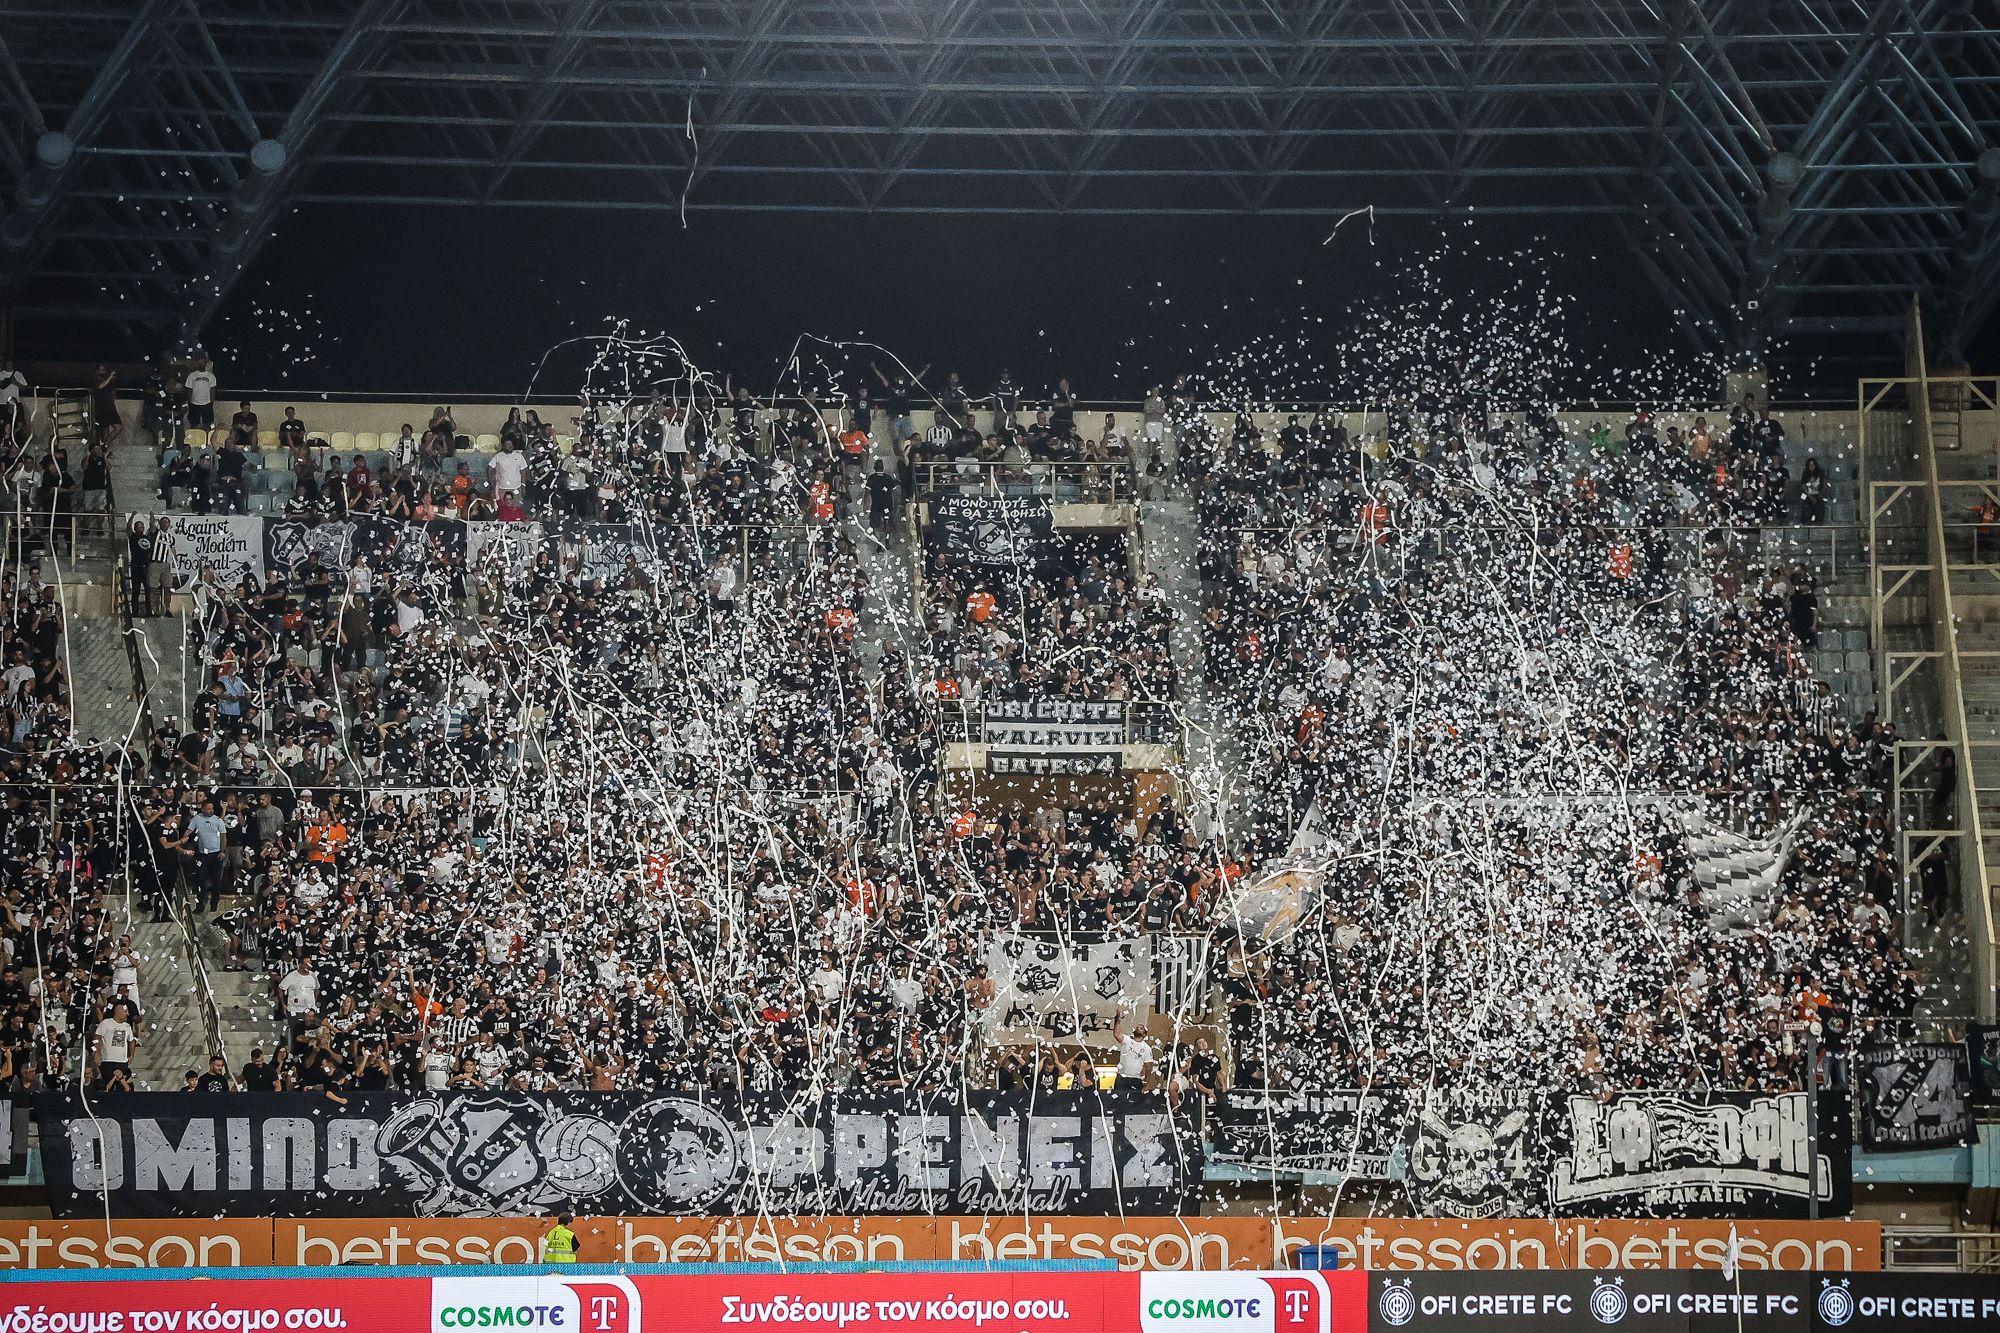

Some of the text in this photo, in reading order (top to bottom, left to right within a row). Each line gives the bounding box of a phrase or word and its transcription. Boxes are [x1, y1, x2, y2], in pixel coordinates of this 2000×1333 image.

[938, 506, 957, 516] ΔΕ
[962, 508, 981, 518] ΘΑ
[174, 517, 230, 541] Against
[195, 535, 248, 554] Modern
[176, 553, 230, 571] Fooall
[1036, 701, 1122, 720] CRETE
[986, 728, 1123, 746] MALEVIZI
[992, 756, 1066, 776] GATE
[1919, 1117, 1967, 1140] team
[1362, 1159, 1389, 1176] YOU
[843, 1174, 950, 1214] Modern
[957, 1175, 1069, 1214] Football
[1476, 1198, 1501, 1218] BOYS
[297, 1225, 547, 1266] betsso
[625, 1222, 905, 1263] betsson
[951, 1220, 1229, 1271] betsson
[1577, 1225, 1852, 1271] betsson
[721, 1293, 1070, 1328] Συνδέουμε τον κόσμο σου.
[1149, 1298, 1261, 1319] COSMOTE
[1420, 1294, 1572, 1316] OFI CRETE FC
[1632, 1294, 1799, 1315] OFI CRETE FC
[1858, 1295, 1896, 1318] OFI
[1901, 1296, 1976, 1318] CRETE
[129, 1311, 181, 1331] τον
[186, 1302, 280, 1333] κόσμο
[284, 1308, 348, 1328] σου.
[440, 1305, 565, 1327] COSMOTE
